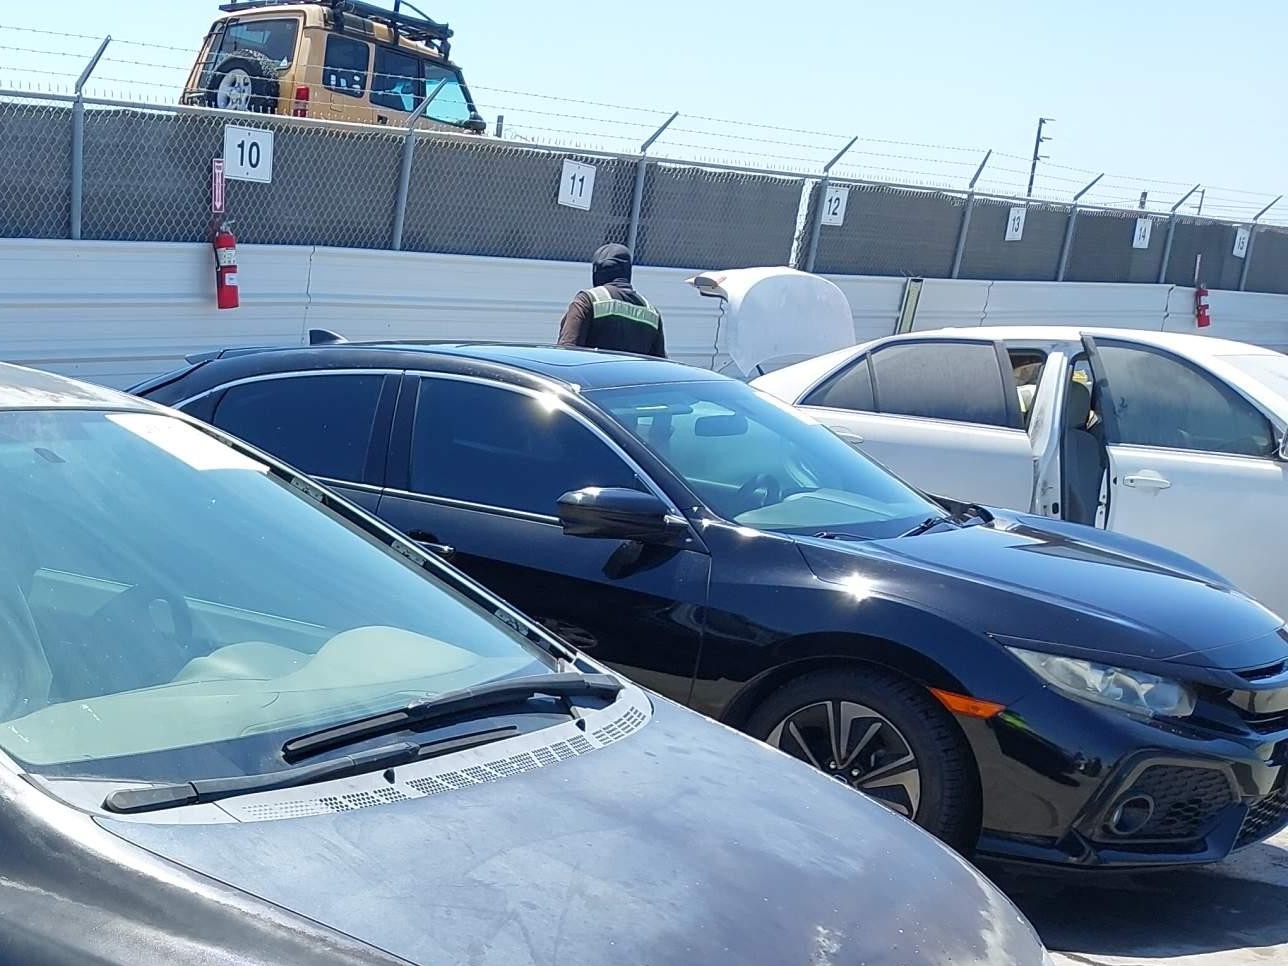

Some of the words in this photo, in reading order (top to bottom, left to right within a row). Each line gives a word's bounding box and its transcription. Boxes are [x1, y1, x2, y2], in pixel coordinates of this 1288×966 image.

[237, 141, 261, 168] 10
[570, 174, 585, 197] 11
[827, 197, 841, 215] 12
[1011, 215, 1021, 233] 13
